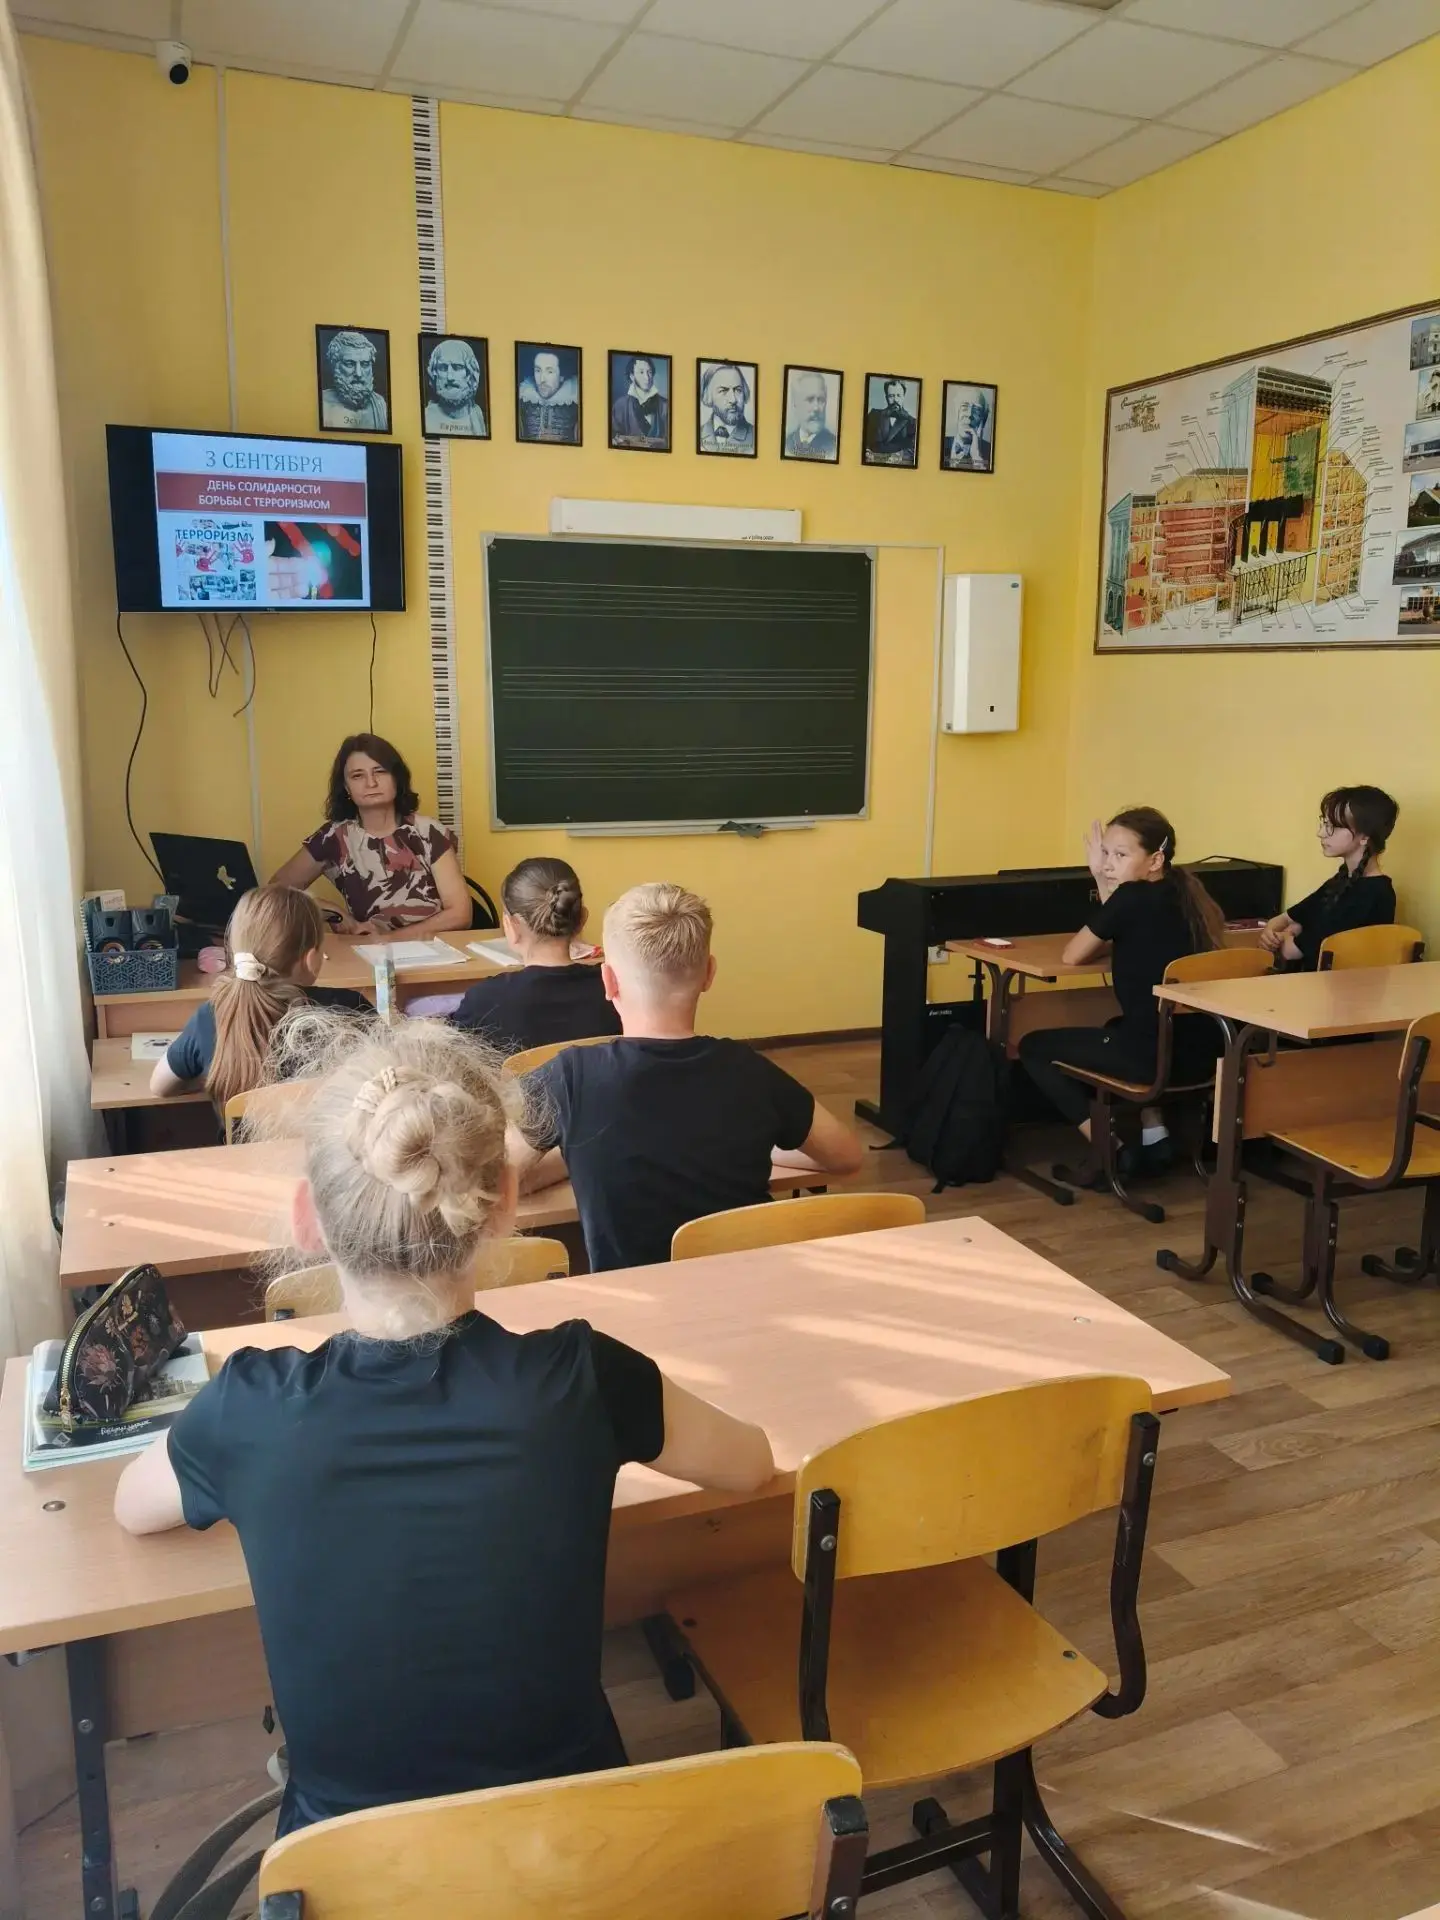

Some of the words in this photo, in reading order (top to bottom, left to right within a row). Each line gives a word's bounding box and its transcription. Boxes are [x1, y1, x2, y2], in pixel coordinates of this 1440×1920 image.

[206, 450, 216, 468] 3
[222, 451, 323, 473] СЕНТЯБРЯ
[207, 480, 236, 492] ДЕНЬ
[237, 481, 321, 494] СОЛИДАРНОСТИ
[198, 495, 242, 506] БОРЬБЫ
[244, 496, 251, 506] С
[253, 497, 331, 510] ТЕРРОРИЗМОМ
